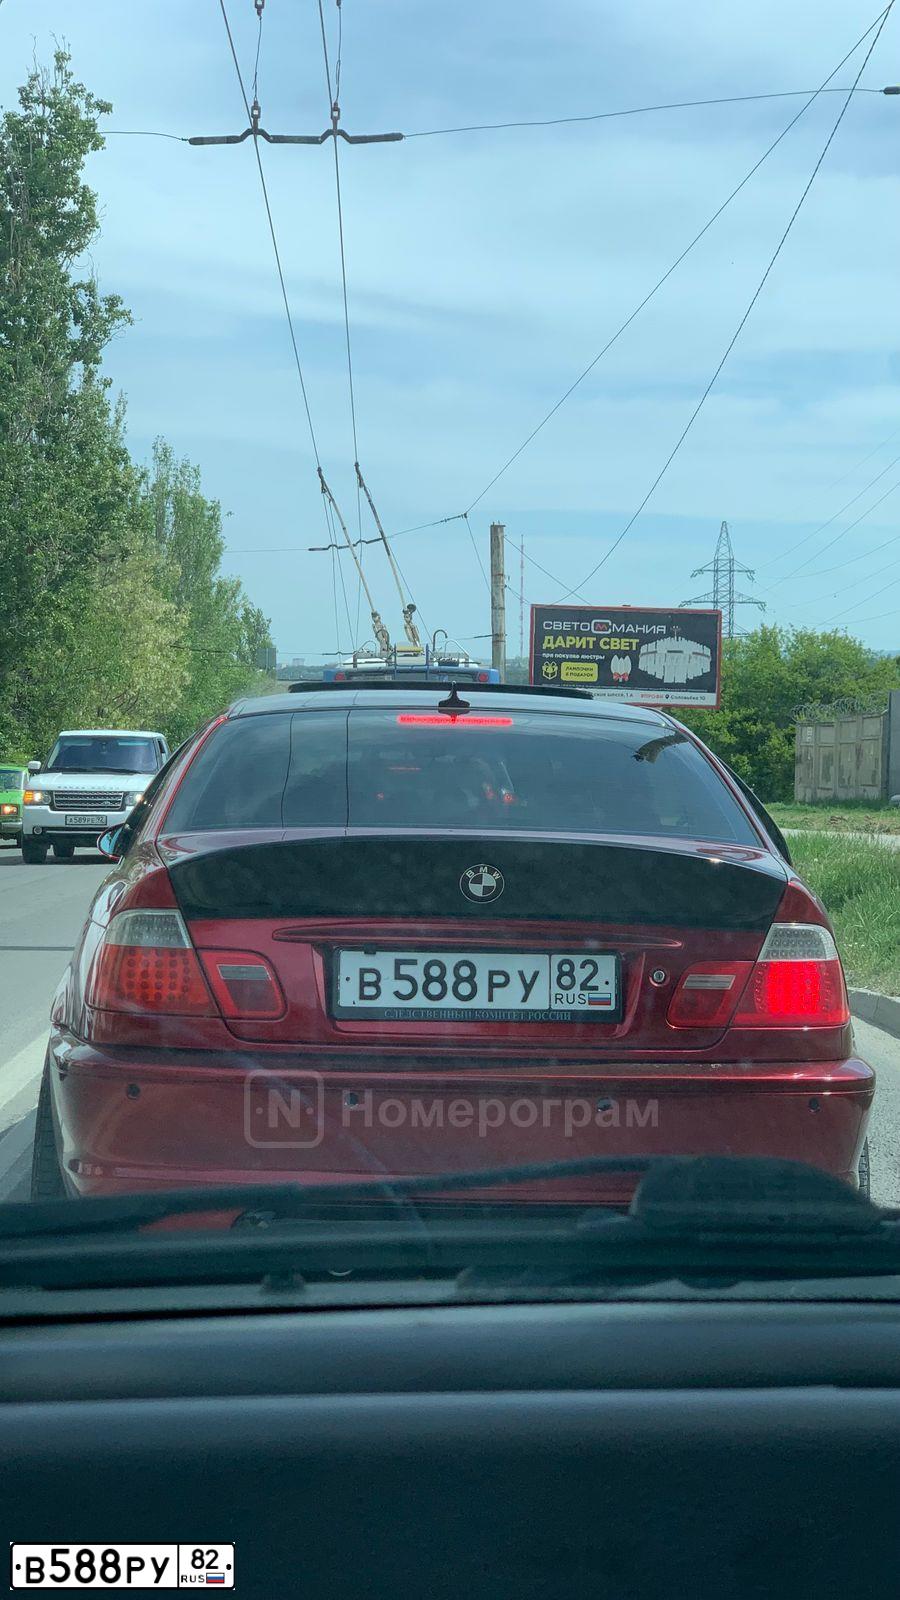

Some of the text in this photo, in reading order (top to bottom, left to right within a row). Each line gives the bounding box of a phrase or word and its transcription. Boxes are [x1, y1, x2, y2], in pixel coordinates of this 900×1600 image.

[542, 635, 639, 650] ДАРИТ СВЕТ
[466, 866, 501, 880] BMW
[358, 958, 599, 1003] В588РУ 82
[554, 993, 587, 1005] RUS
[528, 1010, 571, 1021] РОССИИ
